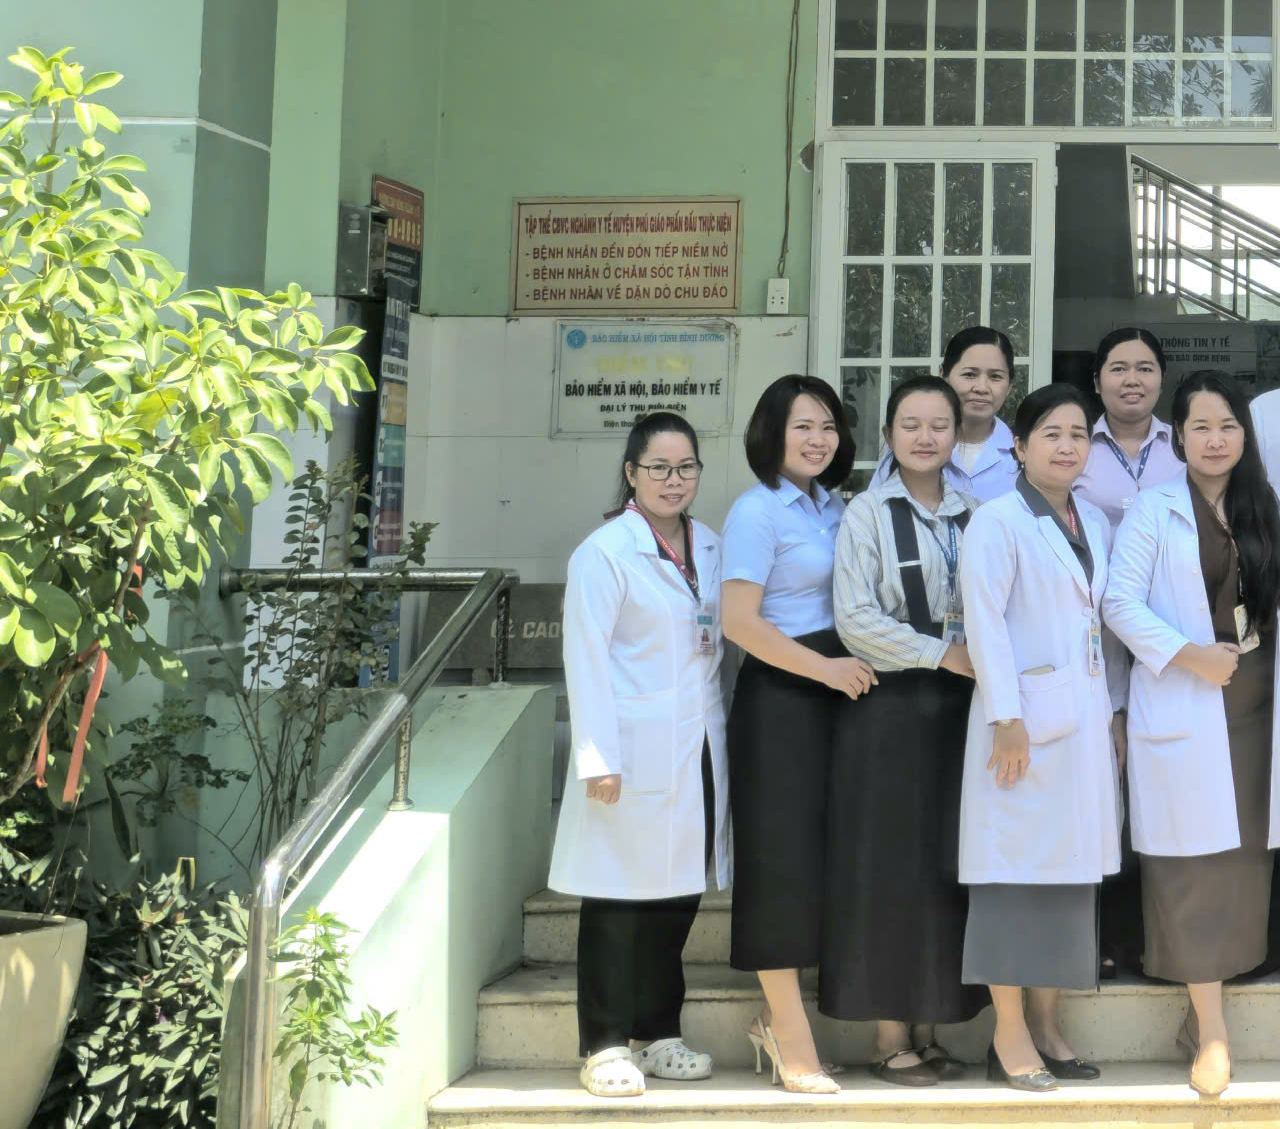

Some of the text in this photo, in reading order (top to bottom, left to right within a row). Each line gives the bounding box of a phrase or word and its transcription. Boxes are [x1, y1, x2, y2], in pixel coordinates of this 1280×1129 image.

[598, 217, 603, 233] Y
[604, 211, 613, 233] TẾ
[533, 244, 564, 260] BỆNH
[567, 244, 598, 258] NHÂN
[601, 242, 625, 258] ĐẾN
[627, 244, 651, 258] ĐÓN
[655, 241, 679, 258] TIẾP
[712, 241, 729, 258] NỞ
[533, 265, 565, 281] BỆNH
[650, 263, 674, 278] SÓC
[703, 262, 729, 278] TÌNH
[533, 285, 566, 302] BỆNH
[625, 284, 651, 301] DẶN
[674, 286, 699, 299] CHU
[703, 282, 728, 298] ĐÁO
[1193, 337, 1209, 348] TIN
[1210, 337, 1217, 348] Y
[565, 376, 722, 398] BẢO HIỂM XÃ HỘI, BẢO HIỂM Y TẾ
[629, 404, 646, 412] THU
